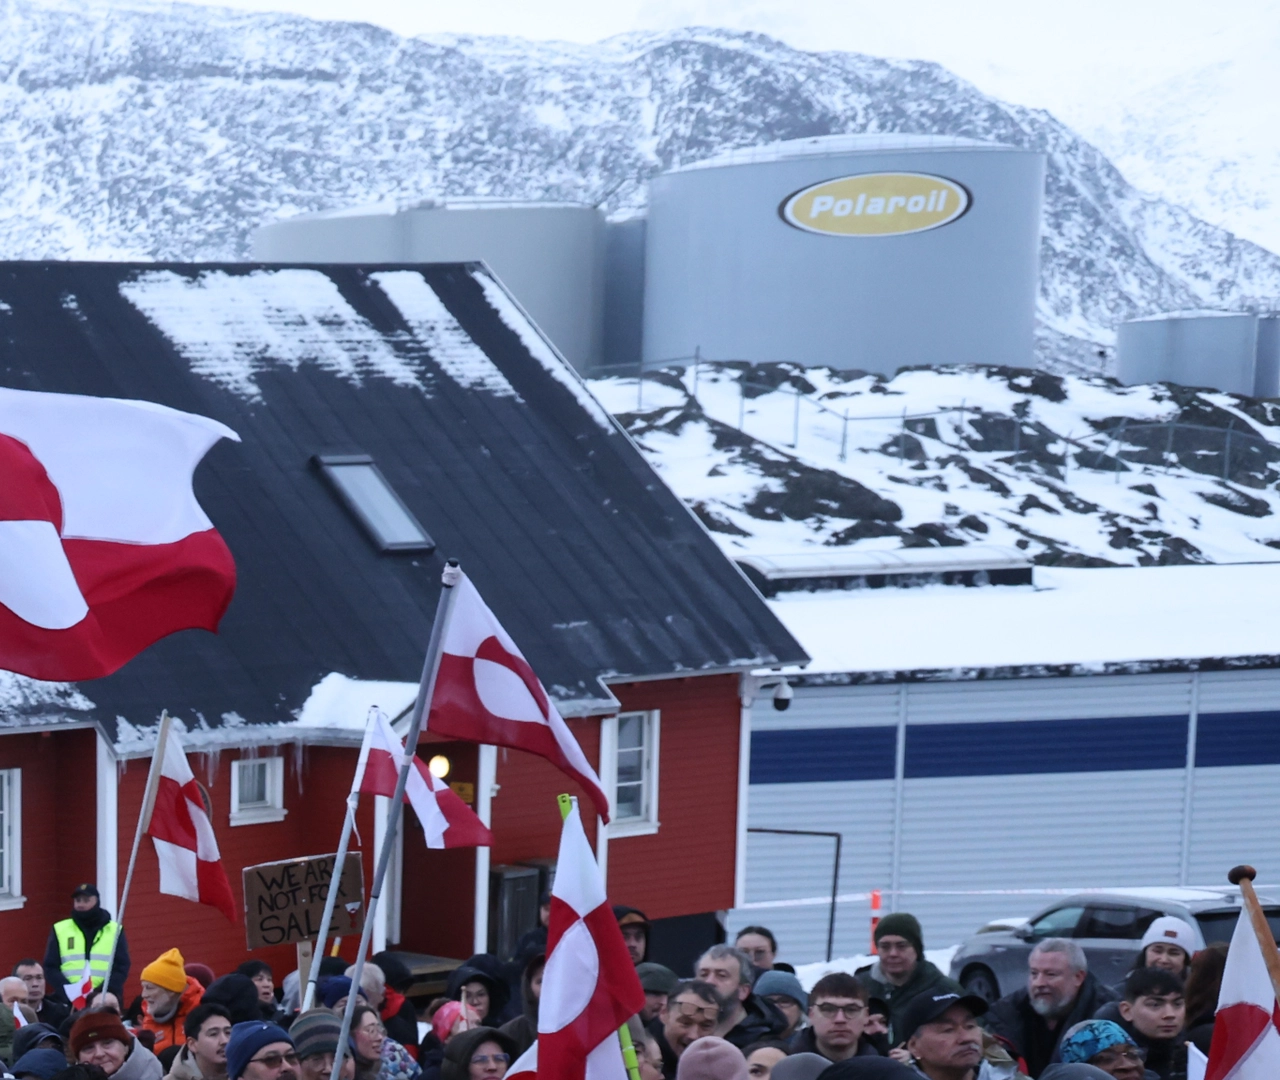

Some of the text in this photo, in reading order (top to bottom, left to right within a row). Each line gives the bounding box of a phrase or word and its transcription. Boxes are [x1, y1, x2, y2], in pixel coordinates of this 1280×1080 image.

[809, 189, 949, 218] Polaroil
[256, 864, 300, 891] WE
[258, 887, 302, 915] NOT
